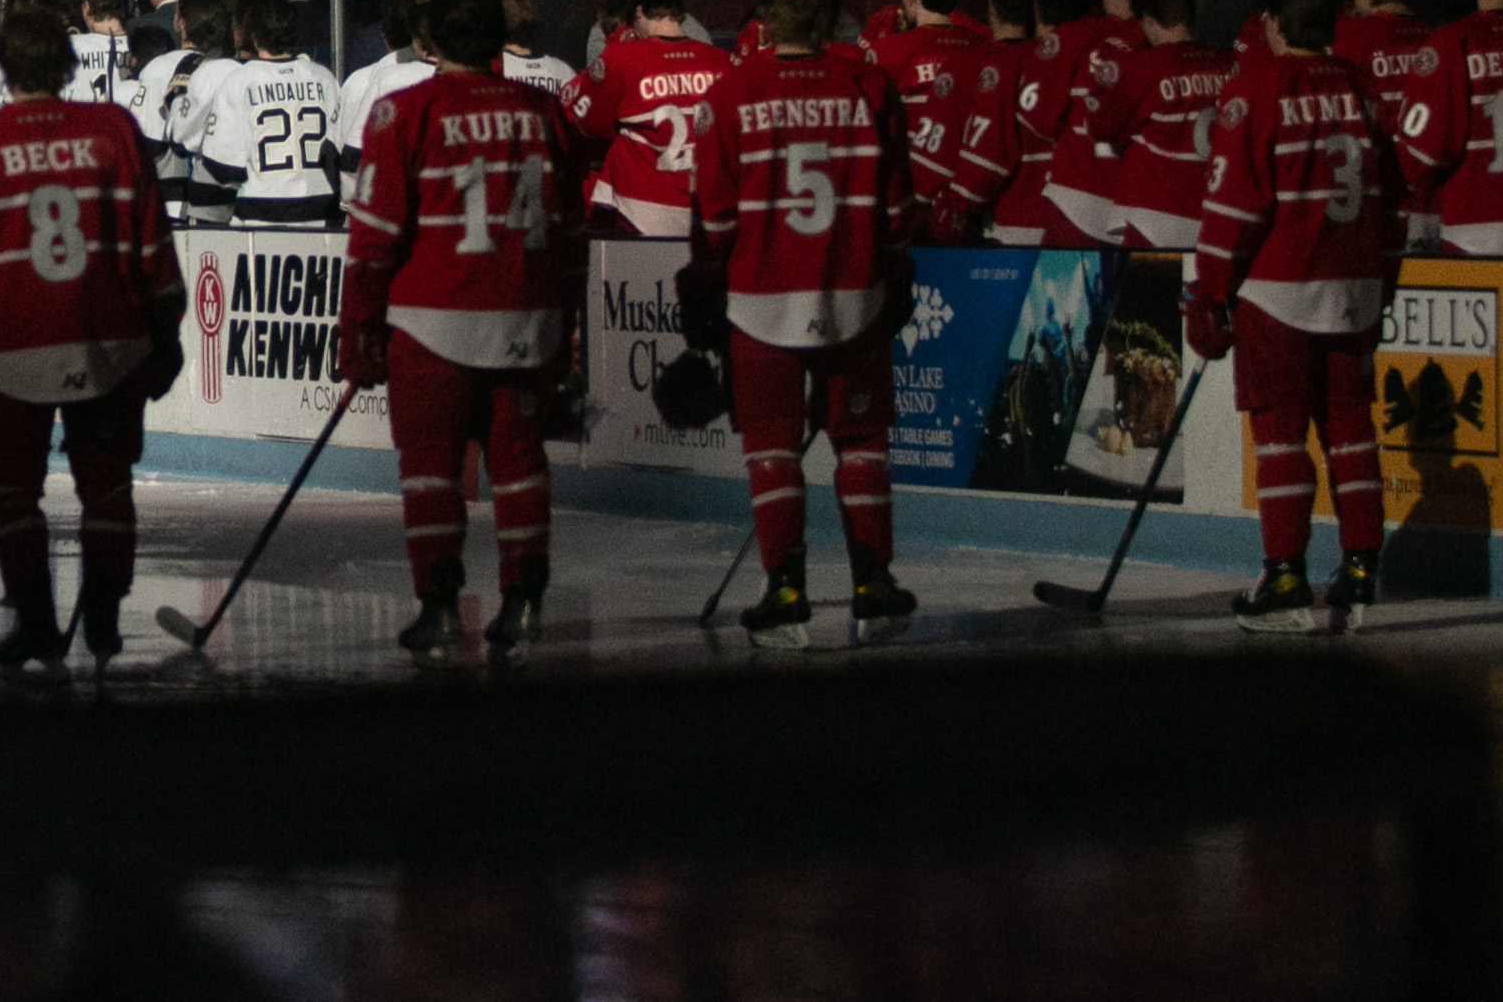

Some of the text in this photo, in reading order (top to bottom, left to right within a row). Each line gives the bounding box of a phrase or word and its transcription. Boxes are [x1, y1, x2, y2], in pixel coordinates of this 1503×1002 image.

[247, 82, 325, 106] LINDAUER
[737, 96, 873, 134] FEENSTRA
[0, 138, 98, 178] BECK
[256, 107, 327, 172] 22
[782, 141, 836, 236] 5
[1323, 134, 1363, 223] 3
[451, 154, 550, 254] 14
[28, 183, 89, 282] 8
[1381, 296, 1488, 349] BELL'S
[300, 388, 310, 410] A
[909, 365, 945, 389] LAKE
[925, 429, 954, 447] GAMES
